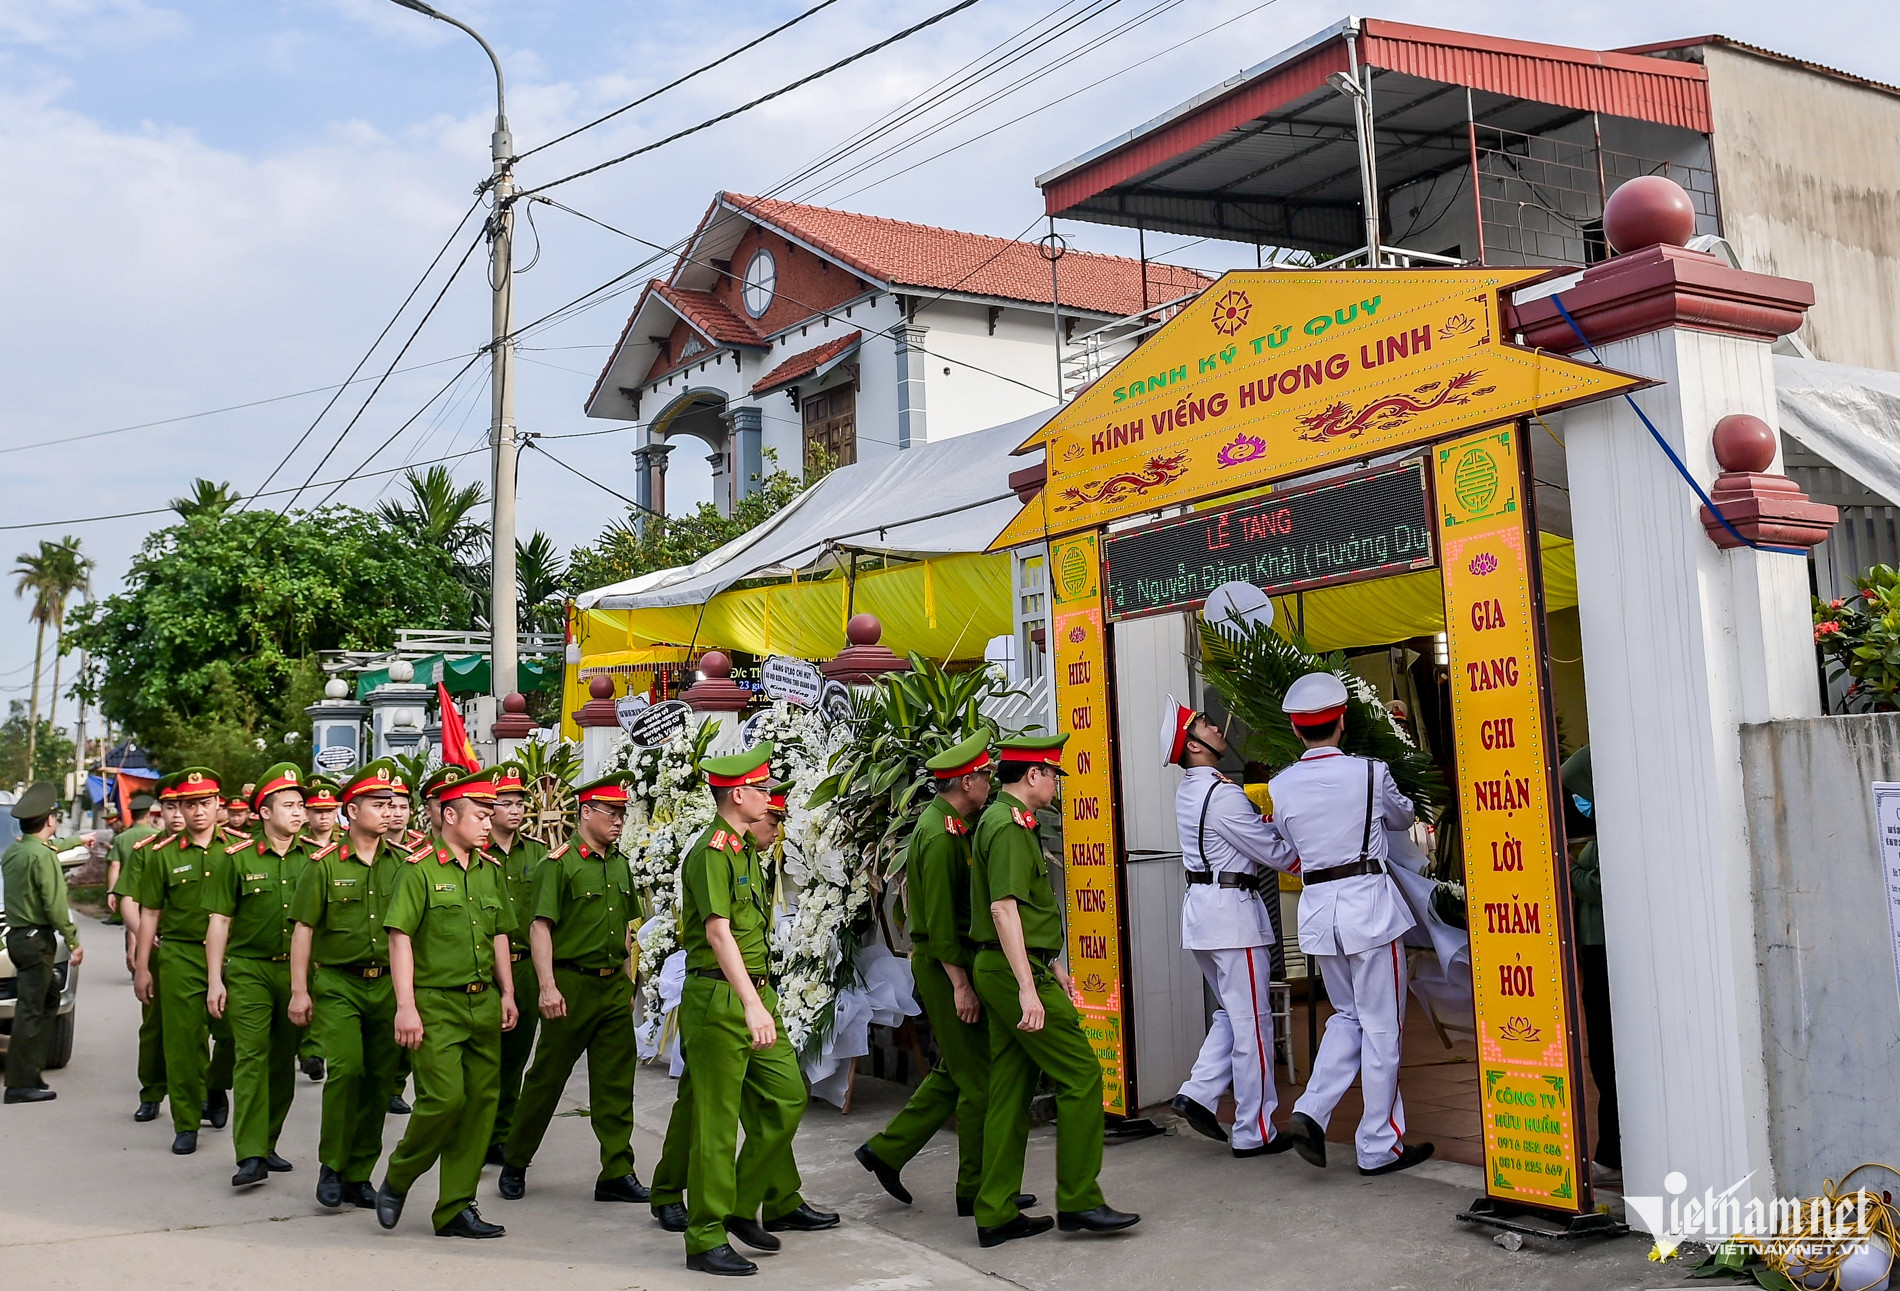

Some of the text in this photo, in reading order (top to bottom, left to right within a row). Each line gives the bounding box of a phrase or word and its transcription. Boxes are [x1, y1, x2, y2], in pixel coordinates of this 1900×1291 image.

[1113, 364, 1187, 404] SANH
[1249, 324, 1293, 355] TỬ
[1303, 295, 1381, 336] QUY
[1091, 324, 1432, 455] KÍNH VIẾNG HƯƠNG LINH
[1207, 508, 1293, 550] LỄ TANG
[1137, 563, 1198, 605] Nguyễn
[1068, 650, 1091, 687] HIẾU
[1077, 749, 1091, 775] ƠN
[1073, 791, 1099, 821] LÒNG
[1466, 598, 1541, 998] GIA TANG GHI NHẬN LỜI THĂM HỎI
[1071, 836, 1106, 866] KHÁCH
[1075, 878, 1106, 913] VIẾNG
[1079, 929, 1107, 960] THĂM
[1084, 1025, 1103, 1040] ÔNG
[1496, 1086, 1556, 1109] CÔNG TY
